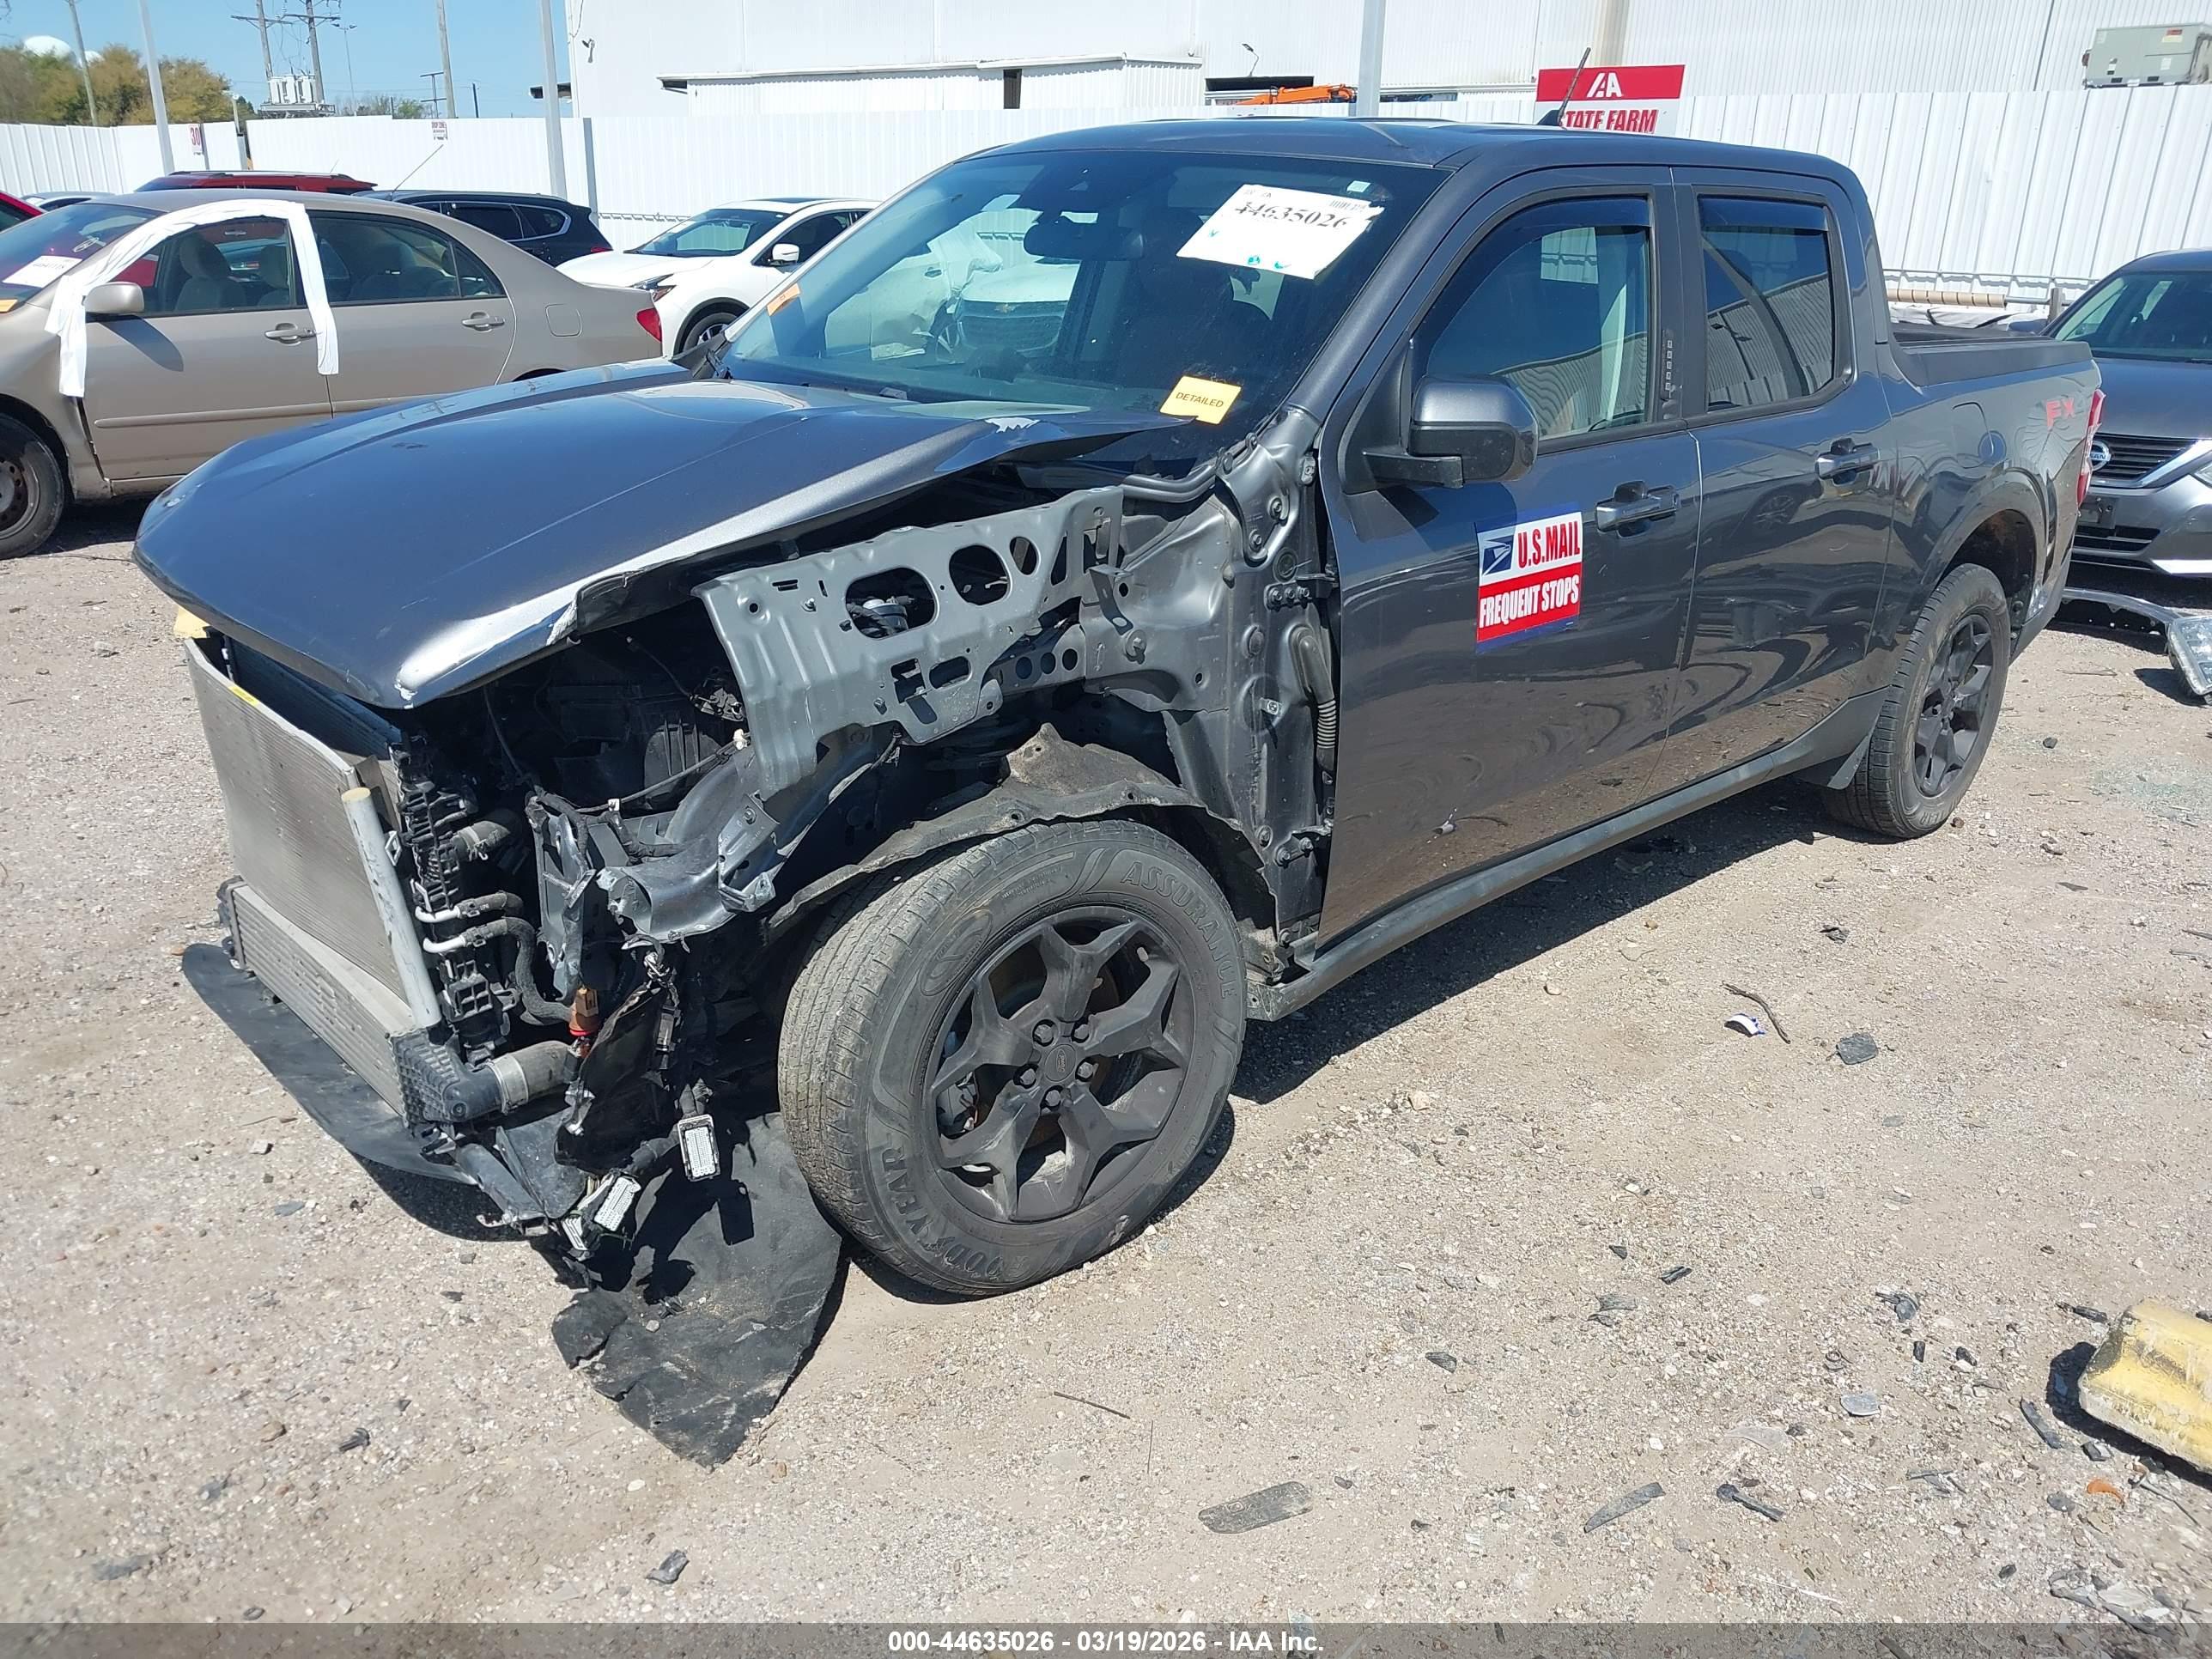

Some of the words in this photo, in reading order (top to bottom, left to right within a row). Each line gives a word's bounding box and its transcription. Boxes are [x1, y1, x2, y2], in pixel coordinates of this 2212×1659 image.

[1606, 109, 1660, 135] FARM
[1235, 202, 1348, 228] 44635026
[1176, 392, 1224, 408] DETAILED
[1479, 584, 1541, 629] FREQUENT
[1541, 574, 1580, 612] STOPS
[1120, 861, 1238, 1000] ASSURANCE
